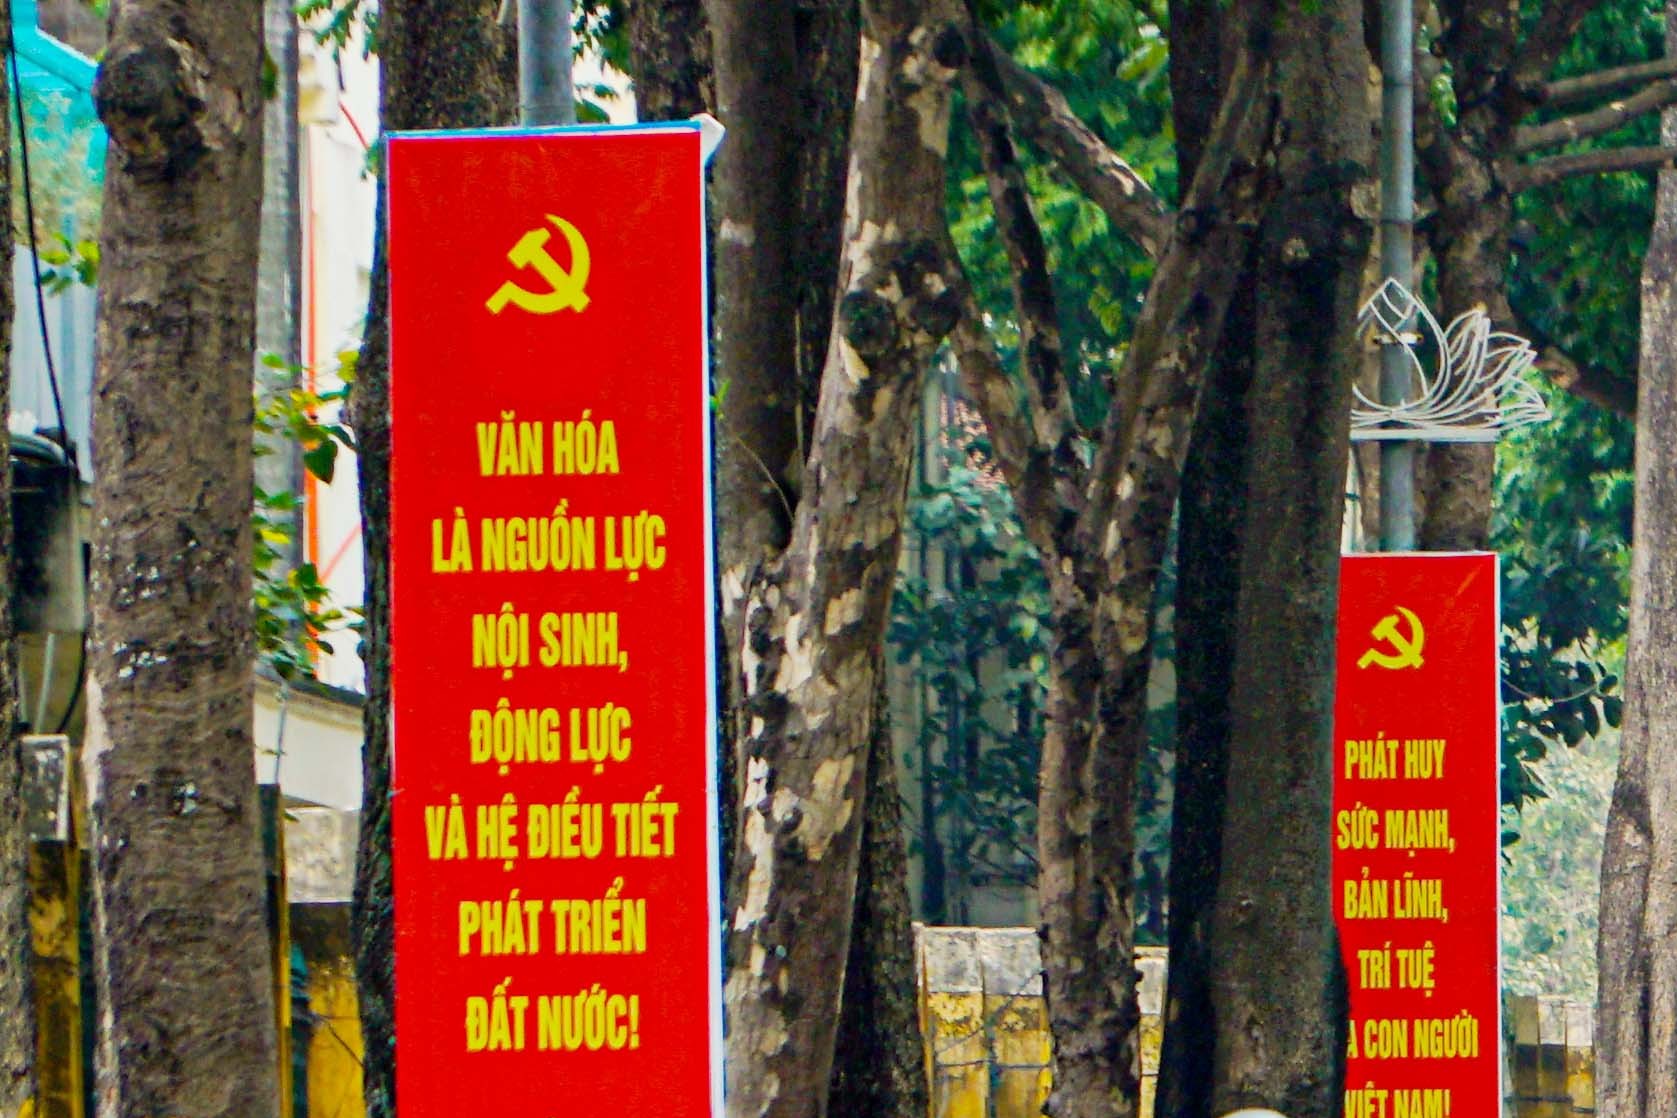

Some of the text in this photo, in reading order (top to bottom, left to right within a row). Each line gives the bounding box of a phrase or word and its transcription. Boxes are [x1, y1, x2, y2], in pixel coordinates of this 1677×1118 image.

[476, 409, 619, 476] VĂN HÓA
[432, 499, 666, 581] LÀ NGUỒN LỰC
[473, 602, 628, 679] NỘI SINH,
[470, 698, 631, 775] ĐỘNG LỰC
[1345, 732, 1446, 779] PHÁT HUY
[425, 785, 679, 871] VÀ HỆ ĐIỀU TIẾT
[1337, 802, 1455, 857] SỨC MẠNH,
[459, 877, 646, 955] PHÁT TRIỂN
[1344, 867, 1448, 923] BẢN LĨNH,
[1358, 941, 1435, 997] TRÍ TUỆ
[466, 977, 639, 1051] ĐẤT NƯỚC!
[1364, 1019, 1408, 1059] CON
[1414, 1009, 1478, 1058] NGƯỜI
